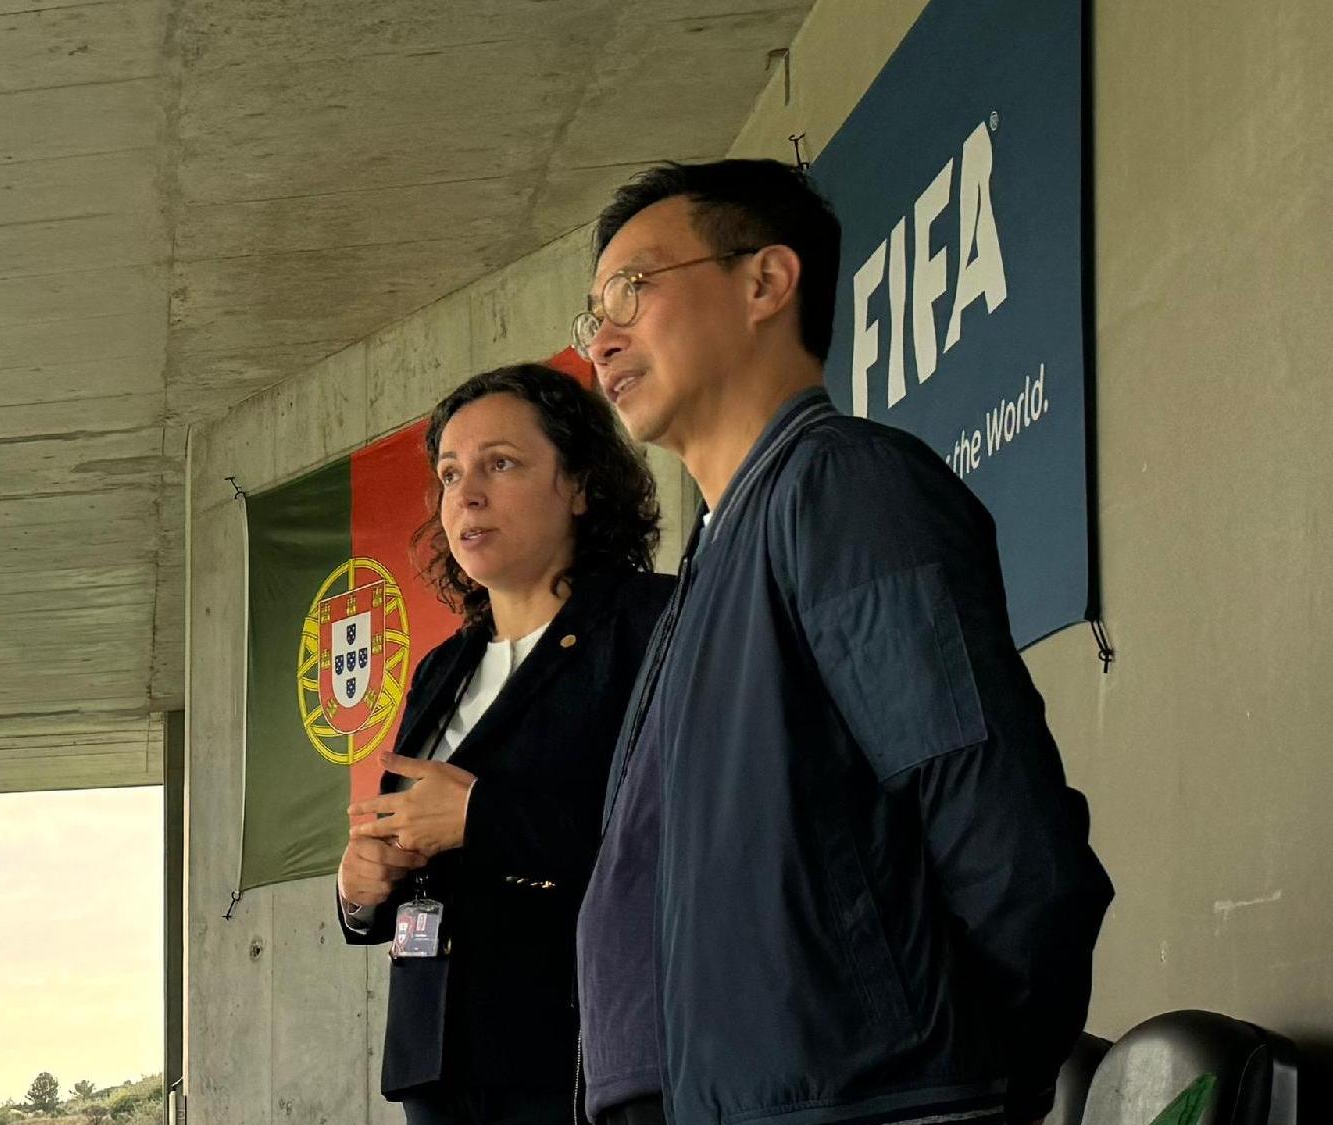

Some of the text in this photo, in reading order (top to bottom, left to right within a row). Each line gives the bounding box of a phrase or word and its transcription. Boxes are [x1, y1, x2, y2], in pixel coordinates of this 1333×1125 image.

[852, 121, 1007, 418] FIFA
[952, 362, 1049, 479] the World.
